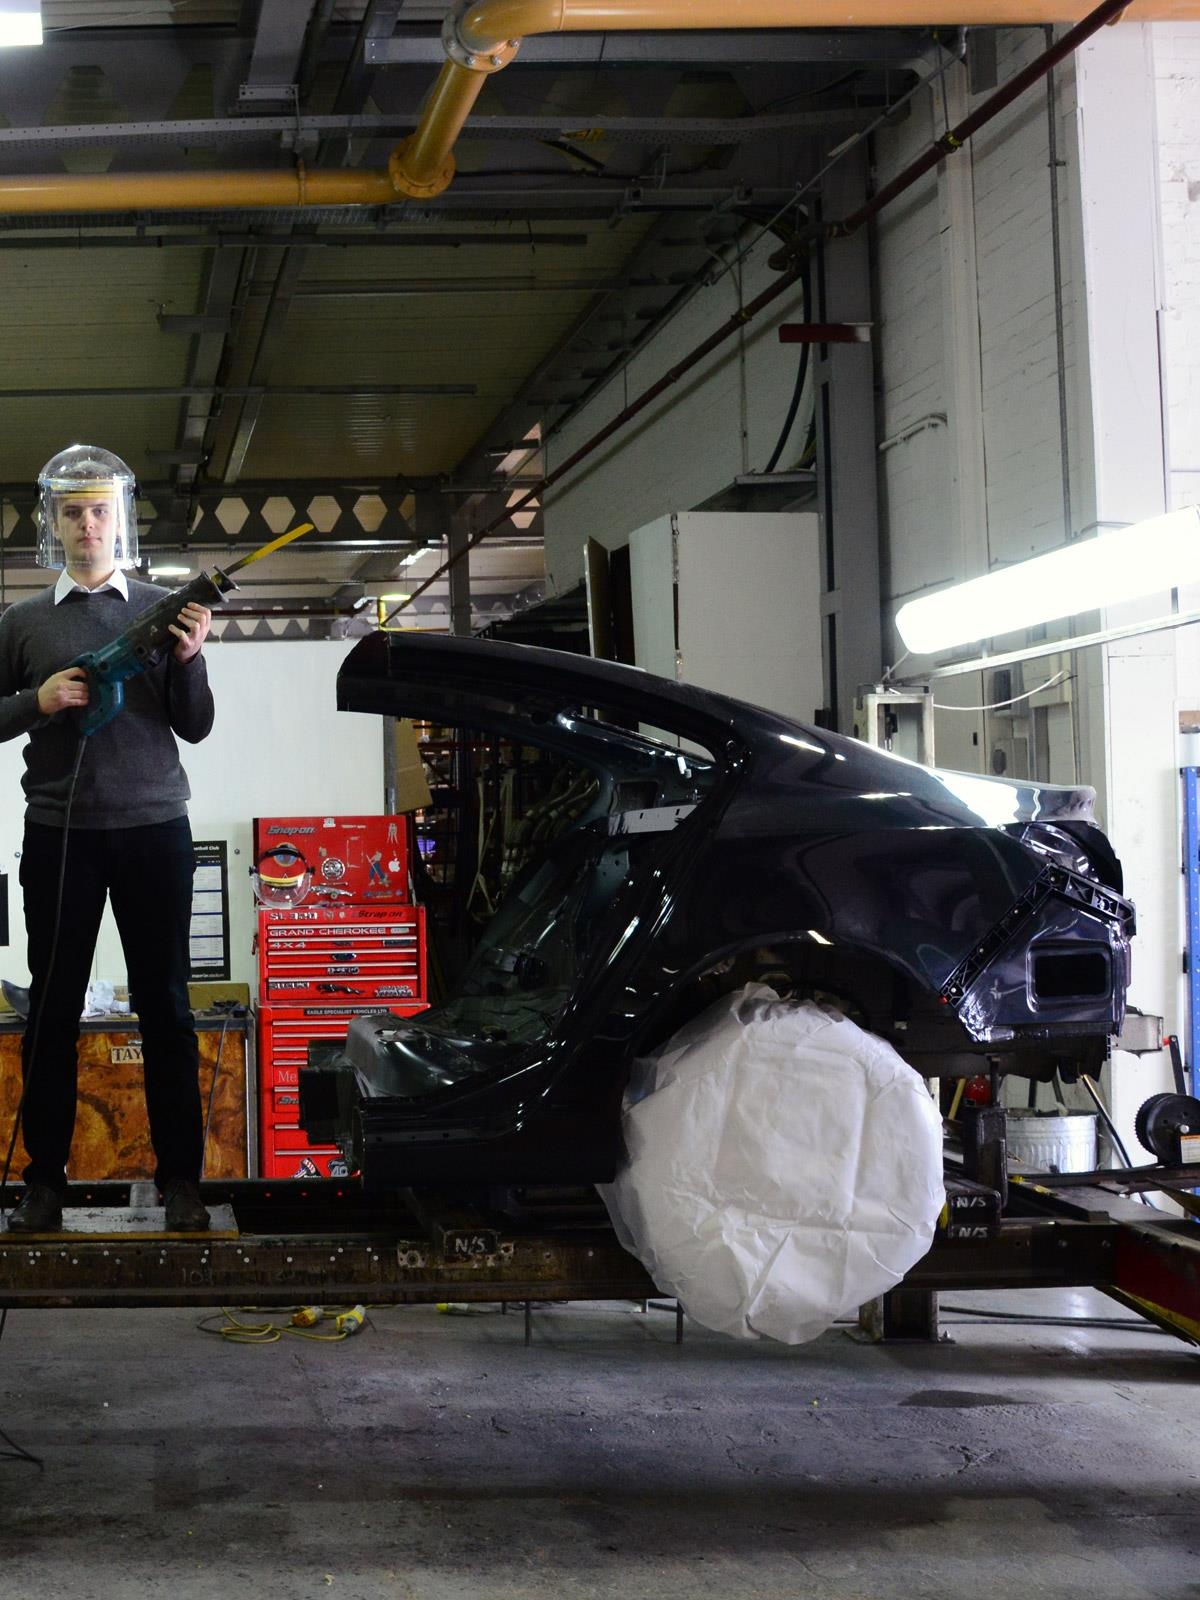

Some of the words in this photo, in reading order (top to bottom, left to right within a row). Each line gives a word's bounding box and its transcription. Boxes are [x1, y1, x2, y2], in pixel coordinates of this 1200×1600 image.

[270, 928, 314, 936] GRAND
[319, 926, 386, 935] CHEROKEE
[957, 1196, 986, 1208] N/S
[959, 1227, 988, 1238] N/S
[455, 1236, 486, 1254] N/S
